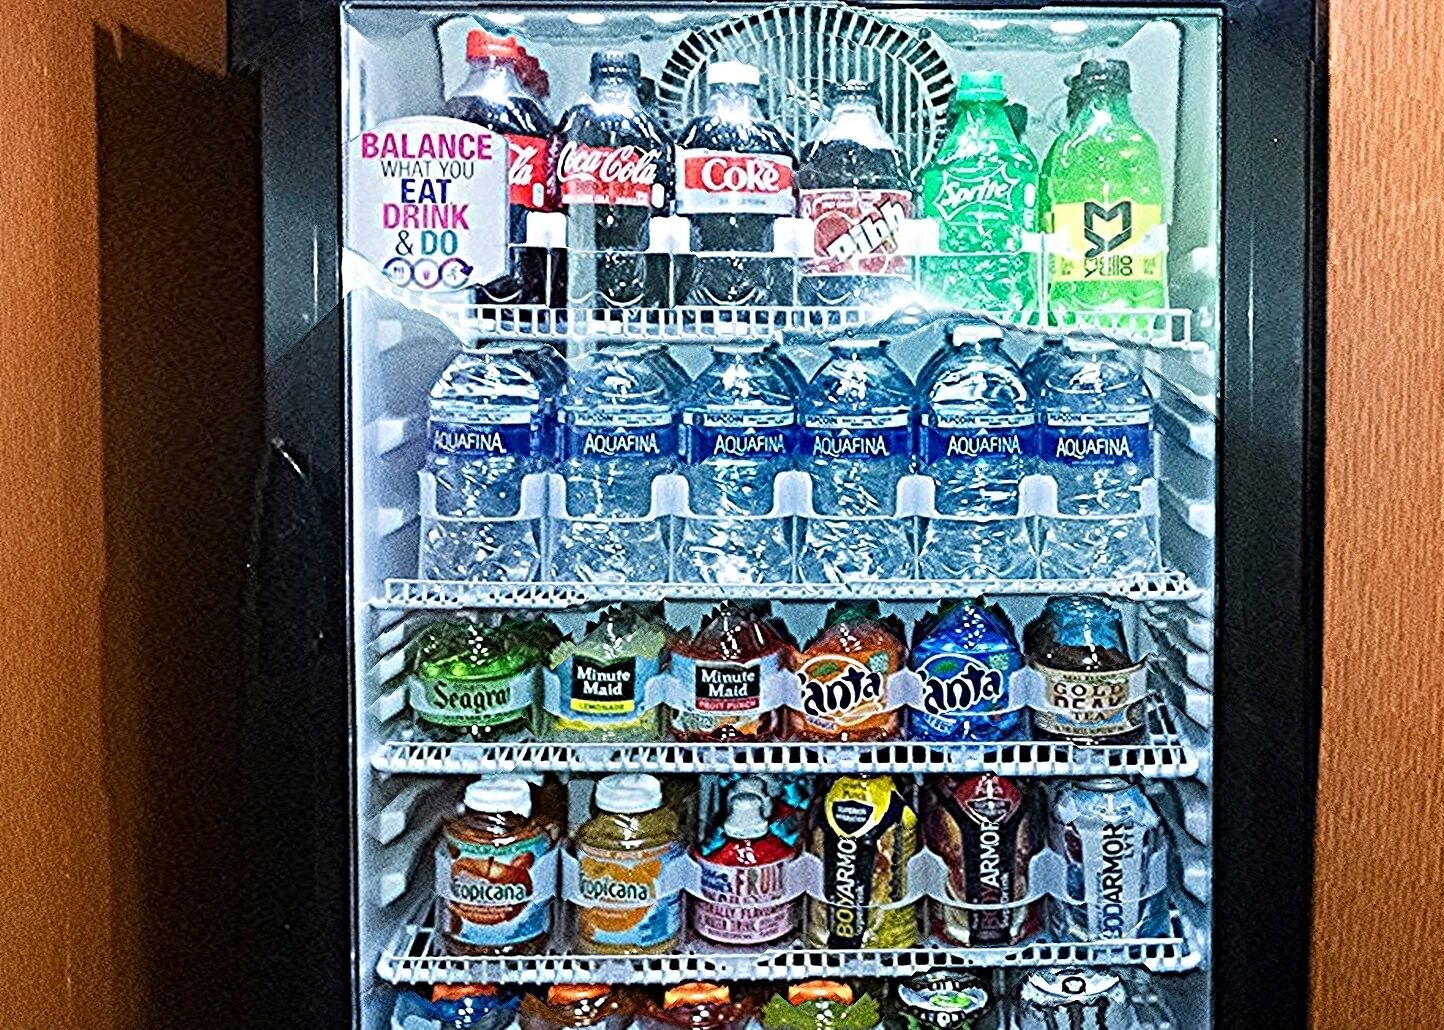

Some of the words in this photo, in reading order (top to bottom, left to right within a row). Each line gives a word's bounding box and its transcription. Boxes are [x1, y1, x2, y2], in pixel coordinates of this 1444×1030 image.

[361, 132, 492, 162] BALANCE
[381, 160, 436, 178] WHAT
[441, 160, 475, 178] YOU
[702, 157, 779, 193] Coke
[400, 178, 452, 205] EAT
[944, 179, 1010, 207] Sprite
[382, 204, 470, 231] DRINK
[395, 229, 415, 256] &
[420, 230, 458, 256] DO
[434, 430, 508, 455] AQUAFINA
[583, 432, 661, 456] AQUAFINA
[714, 432, 787, 456] AQUAFINA
[812, 434, 890, 458] AQUAFINA
[946, 434, 1023, 457] AQUAFINA
[1055, 435, 1134, 460] AQUAFINA
[576, 665, 632, 683] Minute
[701, 665, 756, 684] Minute
[582, 679, 623, 698] Maid
[708, 682, 748, 699] Maid
[800, 665, 882, 716] anta
[921, 664, 1002, 716] anta
[1053, 682, 1123, 697] GOLD
[697, 700, 723, 710] FRUIT
